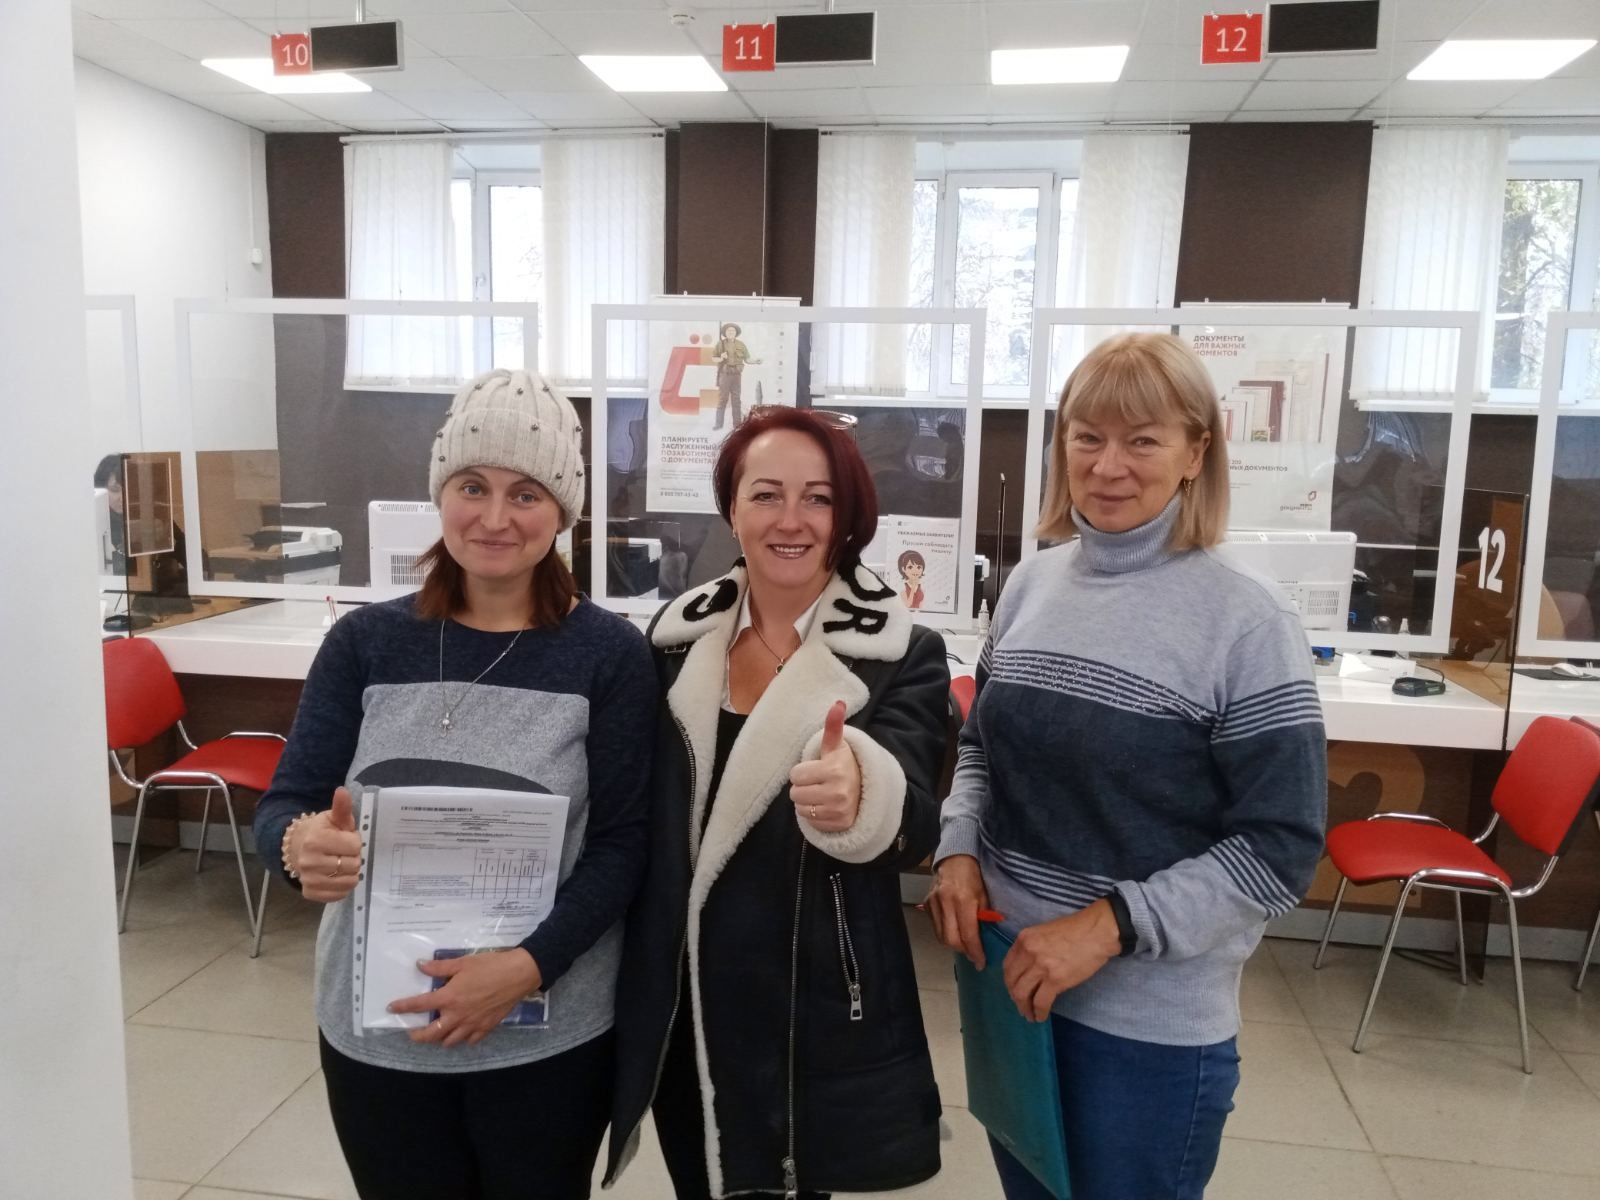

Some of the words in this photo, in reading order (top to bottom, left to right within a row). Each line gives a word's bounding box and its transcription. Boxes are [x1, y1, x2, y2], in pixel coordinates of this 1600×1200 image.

[735, 36, 763, 60] 11
[1216, 27, 1247, 52] 12
[282, 43, 309, 67] 10
[1193, 342, 1210, 350] ДЛЯ
[1210, 342, 1246, 350] ВАЖНЫХ
[661, 443, 717, 451] ЗАСЛУЖЕННЫЙ
[1477, 527, 1506, 594] 12
